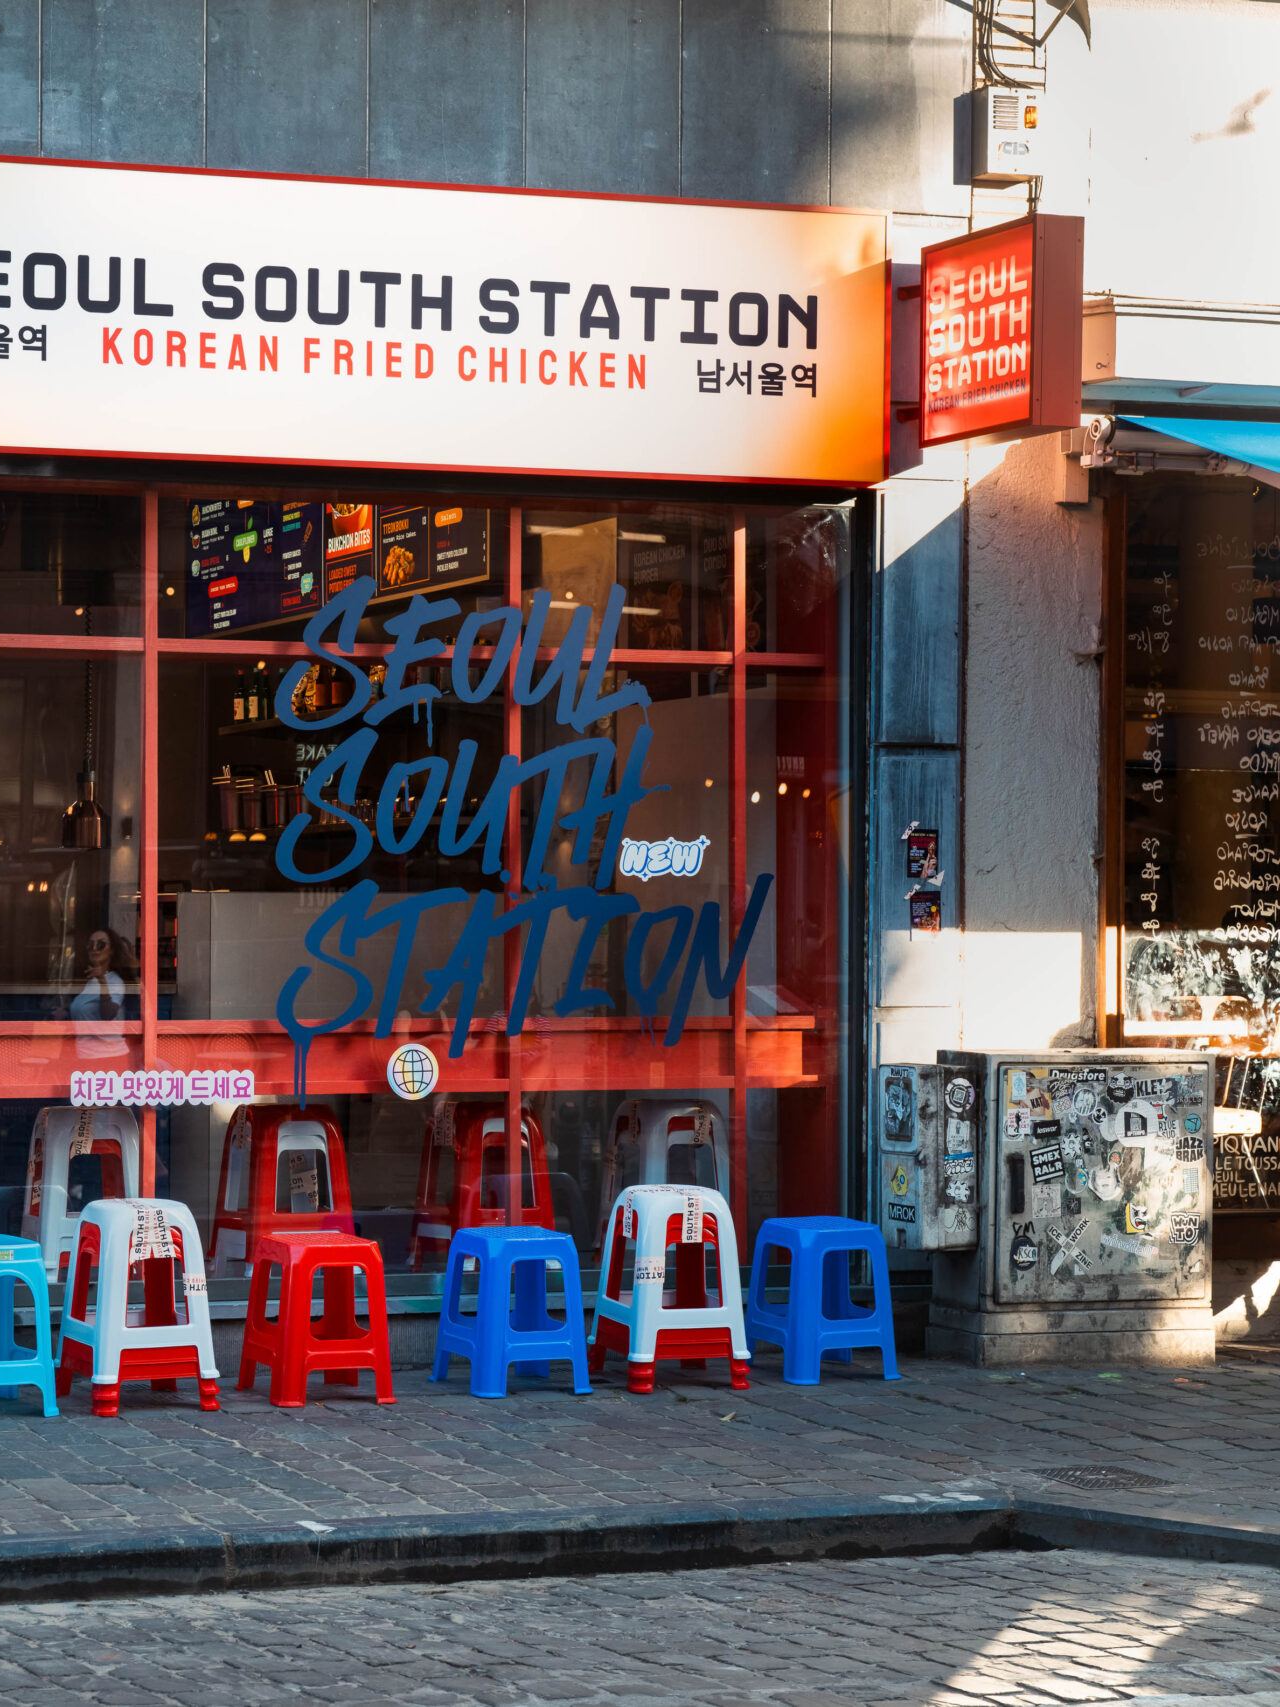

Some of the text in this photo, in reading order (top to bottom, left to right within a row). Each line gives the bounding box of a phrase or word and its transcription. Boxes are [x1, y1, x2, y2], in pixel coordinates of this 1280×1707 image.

[929, 255, 1028, 315] SEOUL
[202, 262, 452, 331] SOUTH
[479, 278, 818, 350] STATION
[928, 296, 1027, 357] SOUTH
[102, 327, 646, 390] KOREAN FRIED CHICKEN
[928, 340, 1026, 393] STATION
[696, 358, 817, 398] 남서울역
[928, 377, 1026, 414] KOREAN FRIED CHICKEN
[328, 529, 370, 553] BUKCHON BITES
[634, 545, 686, 568] KOREAN CHICKEN
[274, 575, 652, 733] SEOUL
[274, 727, 658, 891] SOUTH
[622, 841, 703, 876] NEW
[276, 873, 774, 1060] STATION
[73, 1077, 251, 1101] 치킨 맛있게 드세요
[1051, 1068, 1105, 1081] Drugstore
[1030, 1097, 1043, 1109] KAT
[1033, 1150, 1061, 1166] SMEX
[1176, 1137, 1203, 1150] JAZZ
[1176, 1149, 1204, 1162] BRAK
[1213, 1170, 1245, 1183] EUIL
[1215, 1156, 1280, 1171] LE TOUSS
[156, 1209, 167, 1240] SOUTH
[686, 1213, 694, 1241] SOUTH
[889, 1204, 915, 1221] MROK
[135, 1223, 145, 1254] SOUTH
[1069, 1218, 1090, 1243] WORK
[1175, 1227, 1194, 1240] TO
[1048, 1226, 1093, 1269] ICE ZINE
